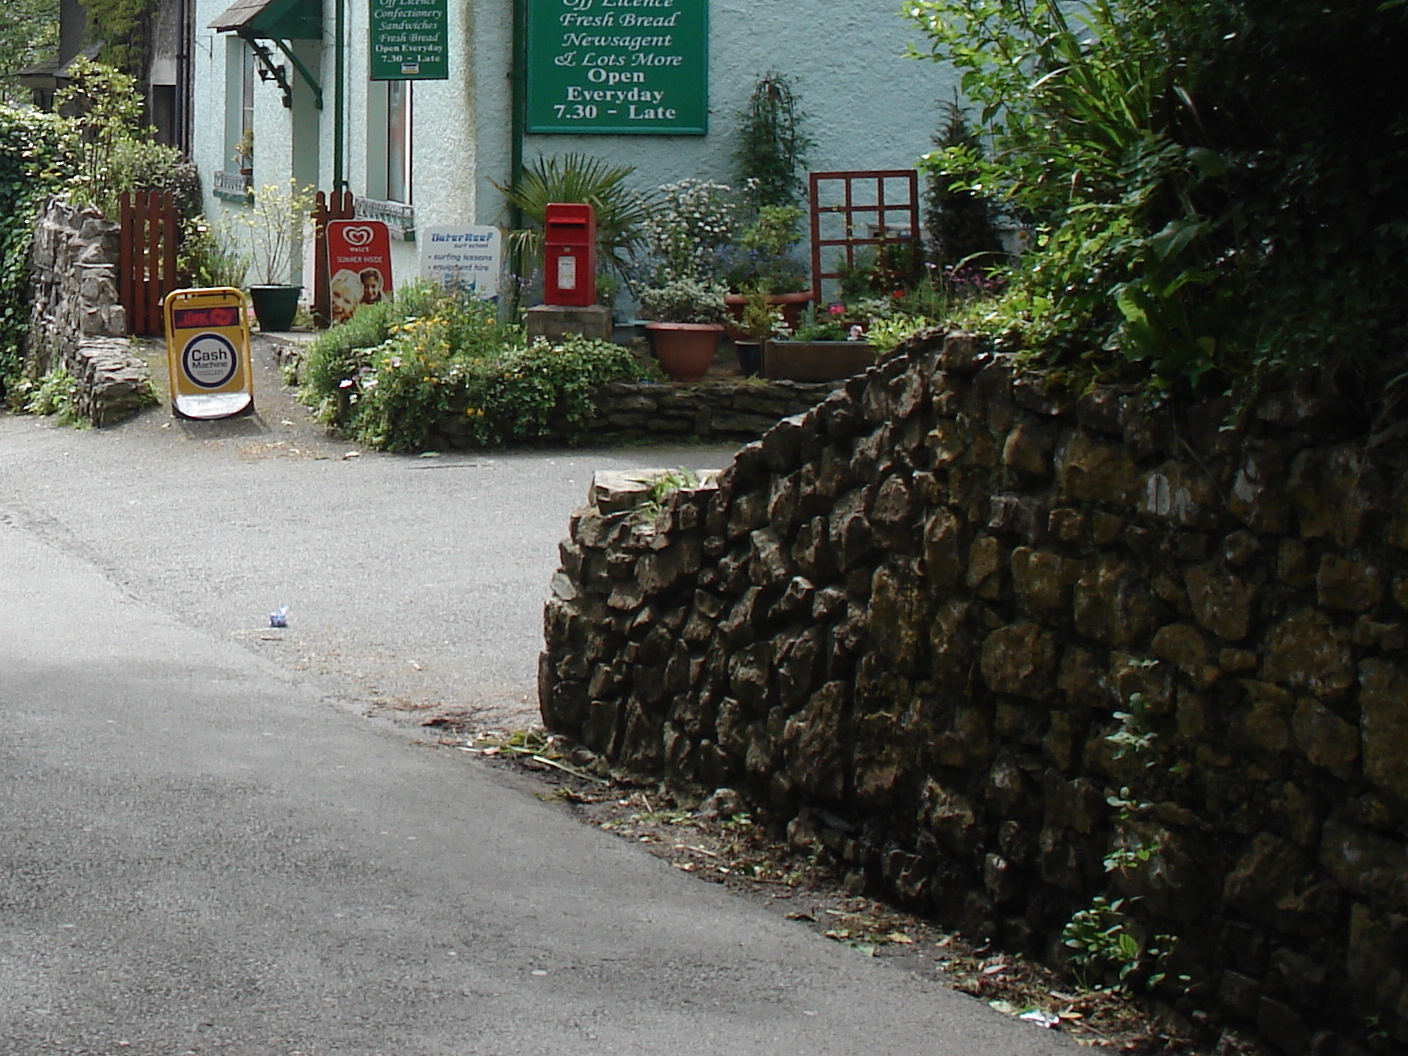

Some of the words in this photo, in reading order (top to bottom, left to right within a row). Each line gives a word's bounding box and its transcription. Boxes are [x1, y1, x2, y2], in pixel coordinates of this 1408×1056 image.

[374, 8, 443, 20] Confectionery
[559, 12, 614, 27] Fresh
[619, 11, 682, 27] Bread
[378, 20, 438, 31] Sandwiches
[379, 32, 407, 43] Fresh
[409, 32, 439, 42] Bread
[562, 33, 672, 50] Newsagent
[375, 44, 400, 54] Open
[401, 44, 444, 54] Everyday
[381, 55, 403, 63] 7.30
[417, 54, 441, 62] Late
[554, 51, 577, 66] &
[581, 52, 626, 66] Lots
[630, 52, 683, 66] More
[588, 68, 645, 85] Open
[567, 87, 664, 103] Everyday
[554, 105, 597, 119] 7.30
[629, 105, 676, 119] Late
[433, 253, 461, 262] surfing
[192, 348, 228, 362] Cash
[192, 361, 228, 369] Machine
